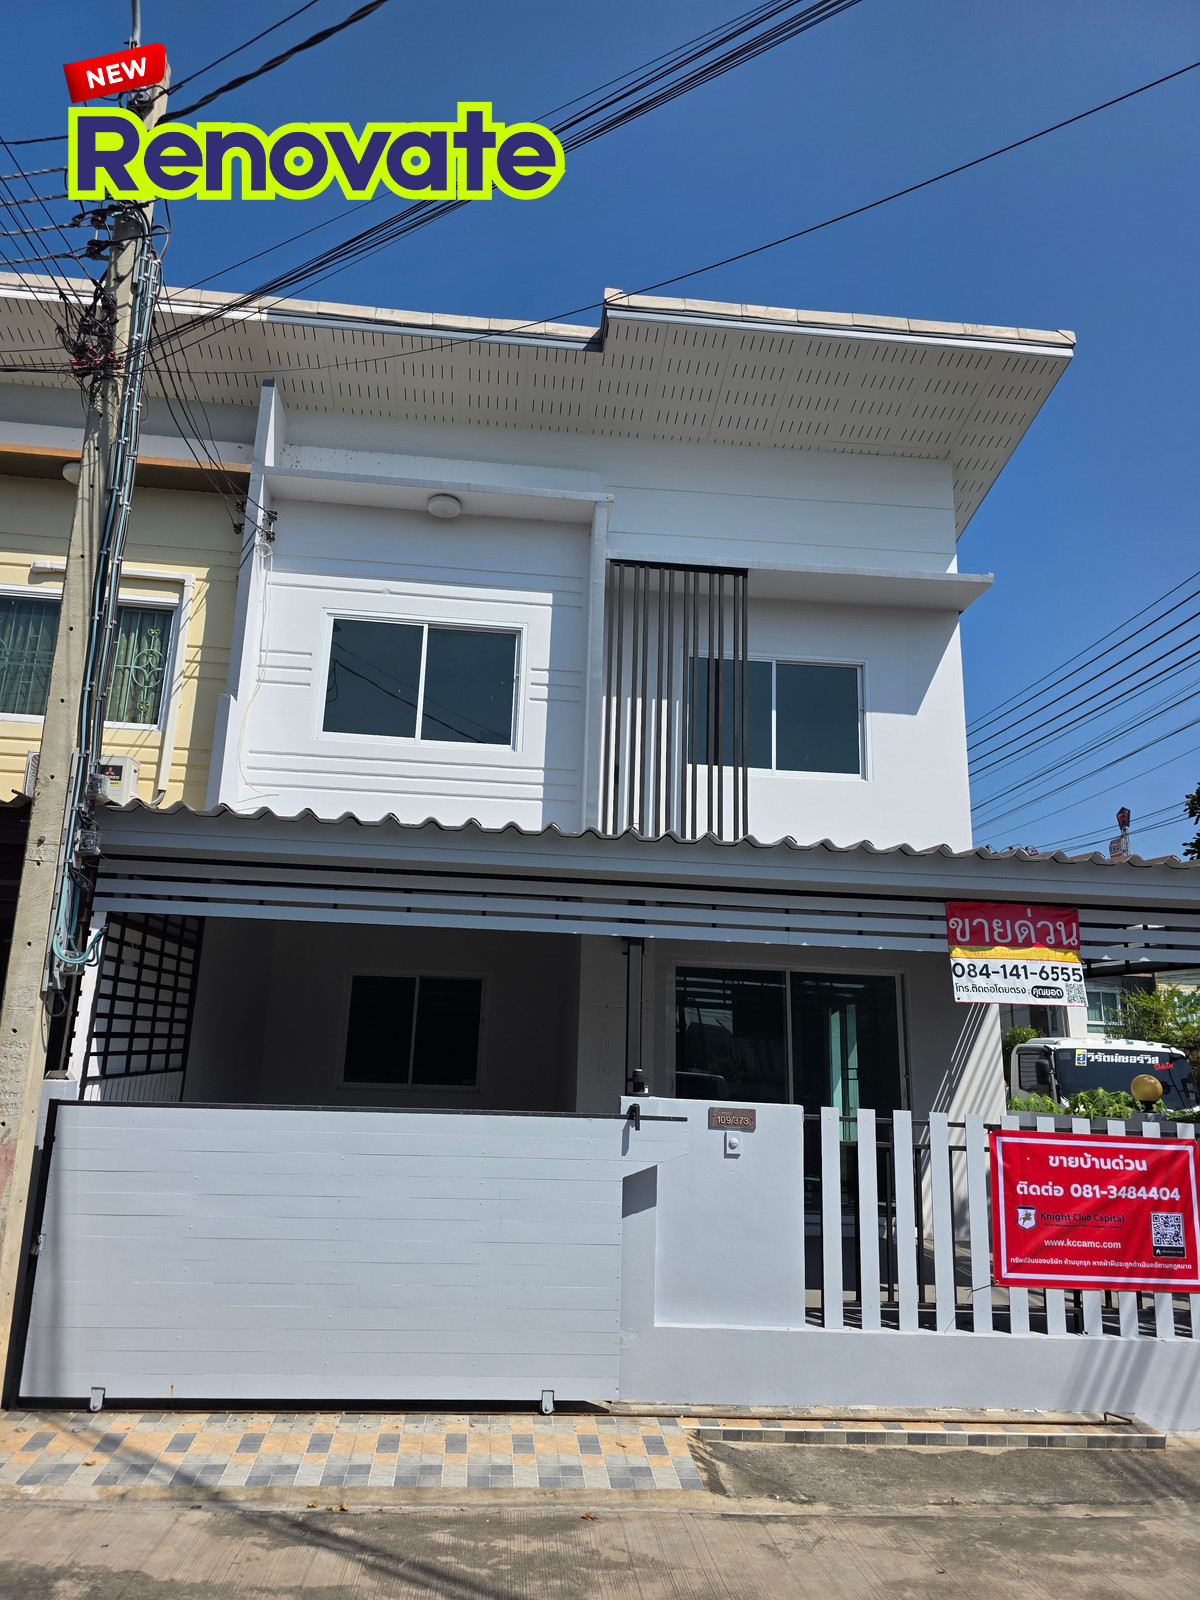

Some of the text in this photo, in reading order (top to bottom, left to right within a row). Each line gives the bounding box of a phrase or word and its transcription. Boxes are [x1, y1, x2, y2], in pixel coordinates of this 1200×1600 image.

[949, 908, 1078, 947] ขายด่วน
[952, 963, 1083, 982] 084-141-6555
[1033, 988, 1063, 998] คุณยอด
[717, 1115, 749, 1125] 109/373
[1048, 1152, 1148, 1172] ขายบ้านด่วน
[1016, 1181, 1181, 1201] ติดต่อ 081-3484404
[1040, 1212, 1125, 1223] Knight Club Capital
[1044, 1238, 1121, 1249] www.kccamc.com
